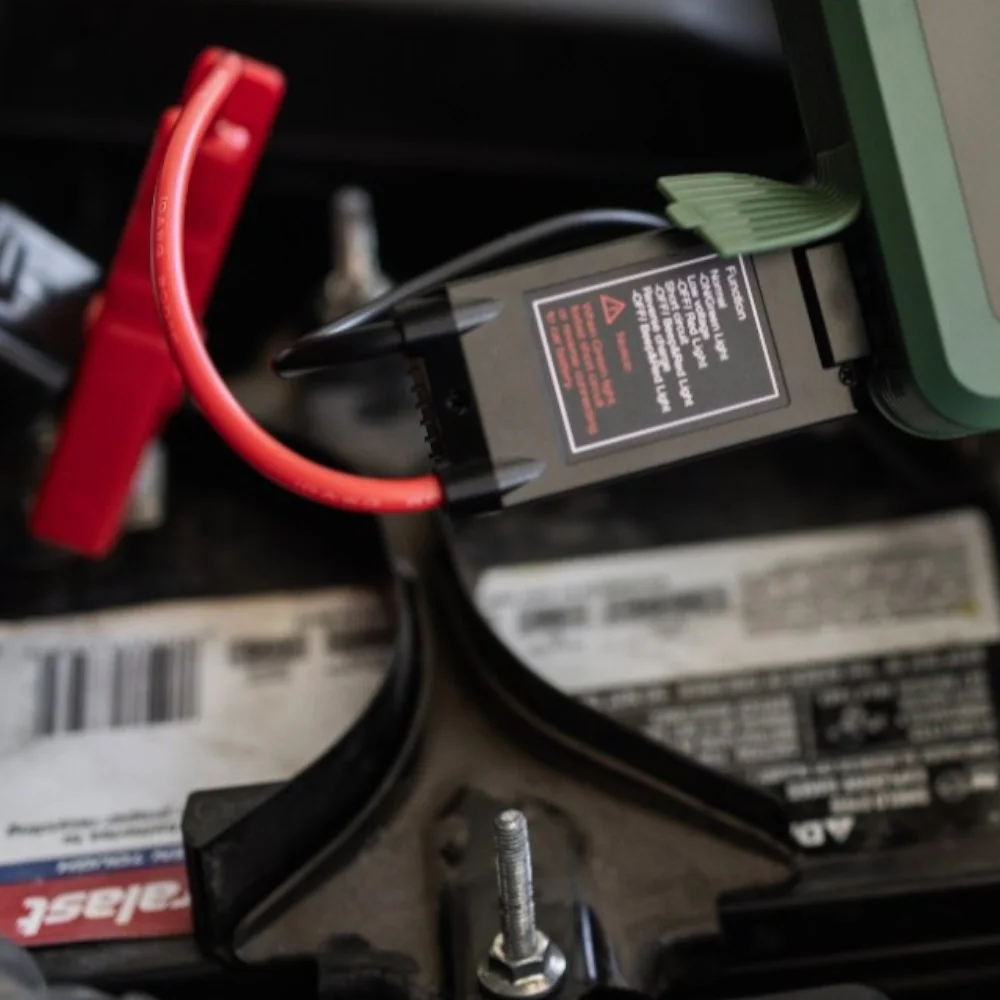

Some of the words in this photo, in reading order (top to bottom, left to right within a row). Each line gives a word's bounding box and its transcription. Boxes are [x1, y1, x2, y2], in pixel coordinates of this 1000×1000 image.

[710, 268, 726, 309] Normal
[727, 266, 746, 320] Function
[642, 285, 661, 332] Reverse
[664, 279, 679, 311] Short
[673, 312, 688, 345] circuit
[685, 312, 698, 335] Red
[687, 273, 699, 297] Low
[693, 300, 710, 341] voltage
[690, 337, 707, 369] Light
[712, 331, 728, 362] Light
[654, 384, 670, 413] Light
[677, 378, 693, 407] Light
